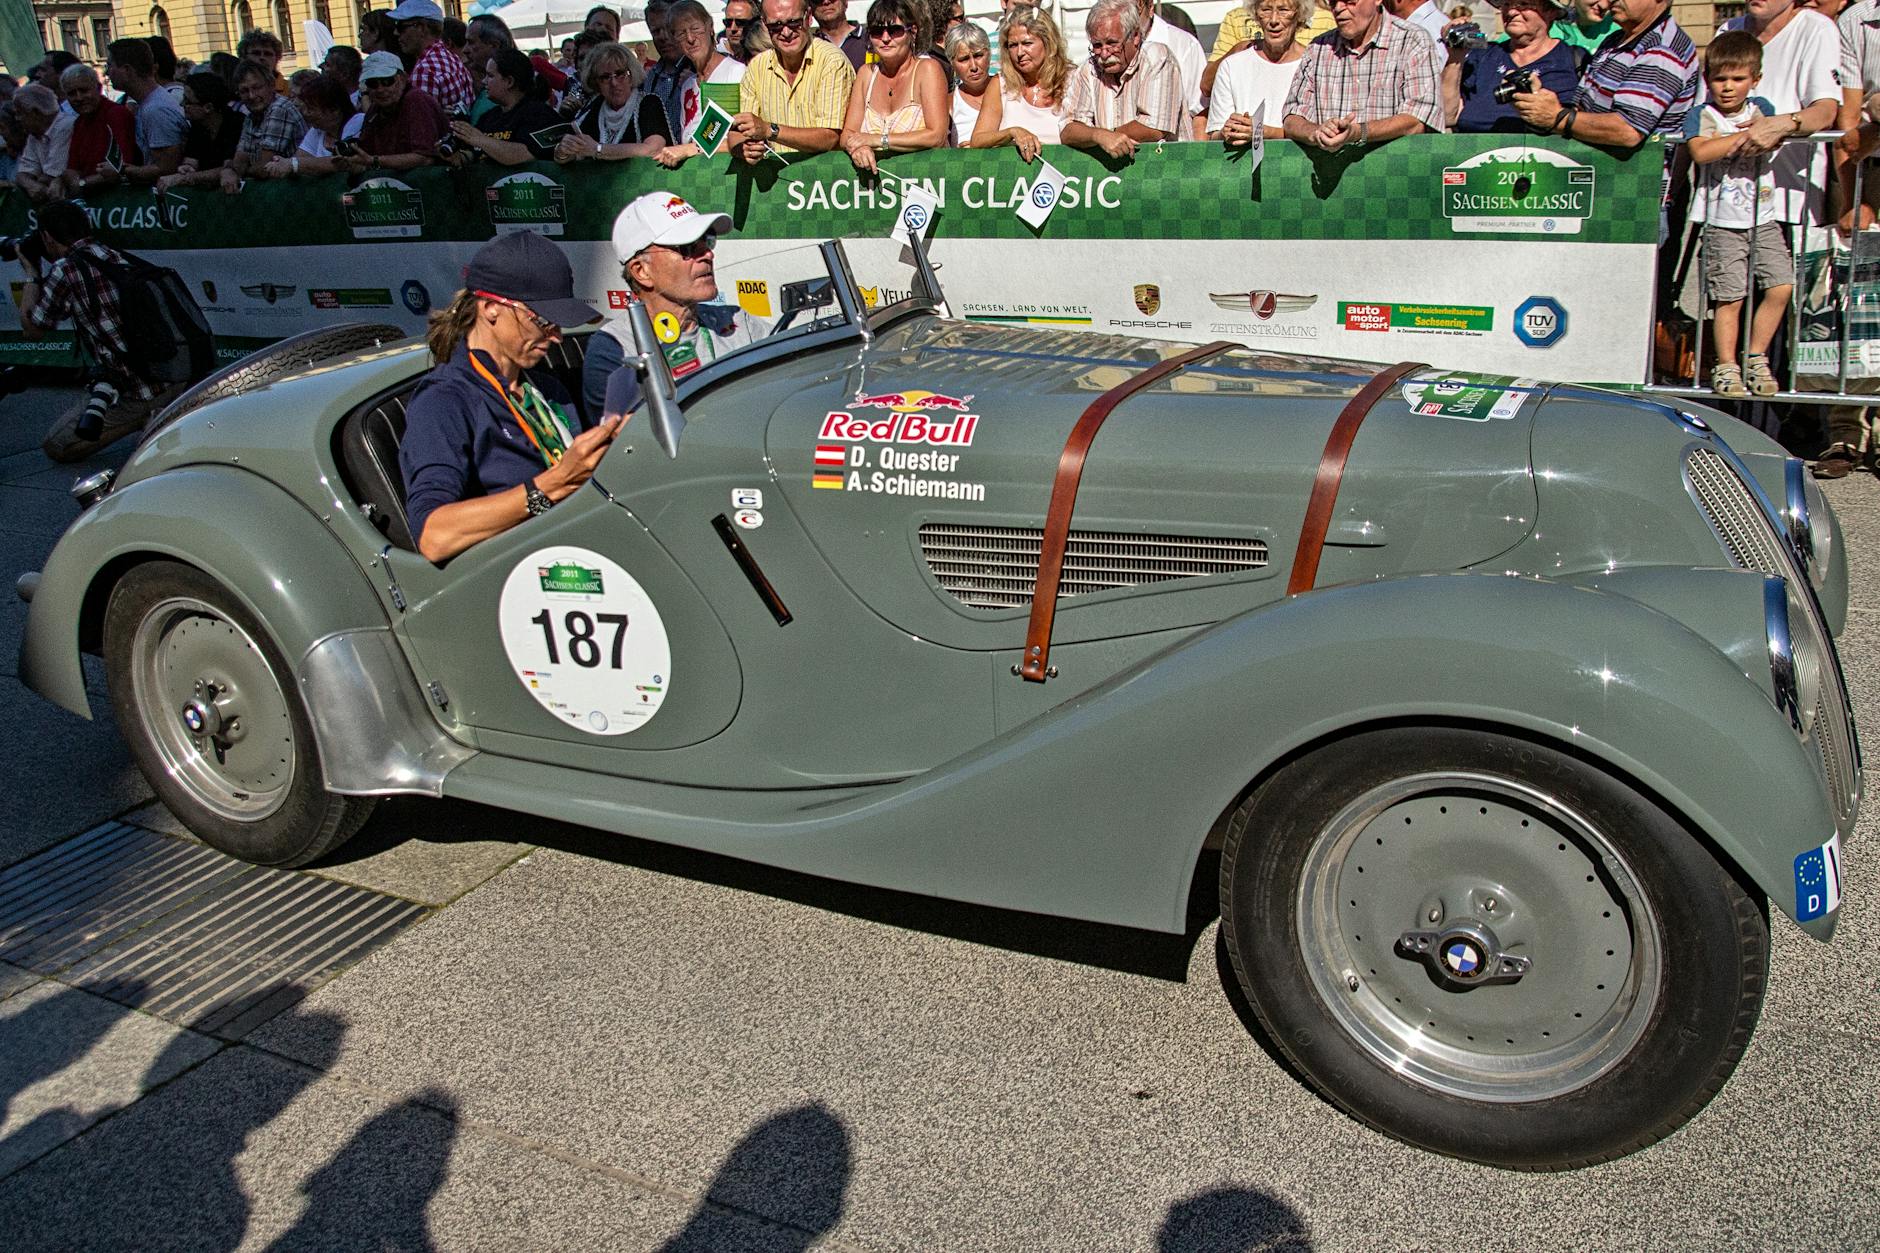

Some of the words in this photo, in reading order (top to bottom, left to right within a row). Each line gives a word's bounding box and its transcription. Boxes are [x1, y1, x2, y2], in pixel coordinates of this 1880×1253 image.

[1497, 171, 1537, 185] 201
[371, 193, 393, 204] 2011
[513, 189, 535, 200] 2011
[962, 177, 1122, 209] CLASIC
[1453, 192, 1519, 210] SACHSEN
[1524, 191, 1583, 210] CLASSIC
[108, 204, 188, 230] CLASIC
[350, 209, 386, 223] SACHSEN
[387, 206, 420, 221] CLASSIC
[493, 204, 528, 219] SACHSEN
[529, 204, 561, 218] CLASSIC
[738, 282, 766, 295] ADAC
[963, 303, 1009, 313] SACHSEN.
[1013, 305, 1036, 313] LAND
[1040, 305, 1059, 313] VON
[1063, 305, 1092, 314] WELT.
[1347, 305, 1380, 315] auto
[1109, 319, 1192, 329] PORSCHE
[1350, 315, 1386, 323] motor
[1415, 316, 1468, 329] Sachsenring
[1210, 323, 1318, 337] ZEITENSTRÖMUNG
[1359, 322, 1389, 331] sport
[1796, 347, 1839, 361] HMANN
[820, 412, 899, 441] Red
[899, 415, 977, 445] Bull
[850, 446, 872, 469] D.
[880, 447, 960, 473] Quester
[560, 569, 579, 578] 2011
[544, 579, 573, 590] SACHSEN
[574, 580, 601, 591] CLASSIC
[531, 608, 629, 670] 187
[1808, 894, 1820, 913] D
